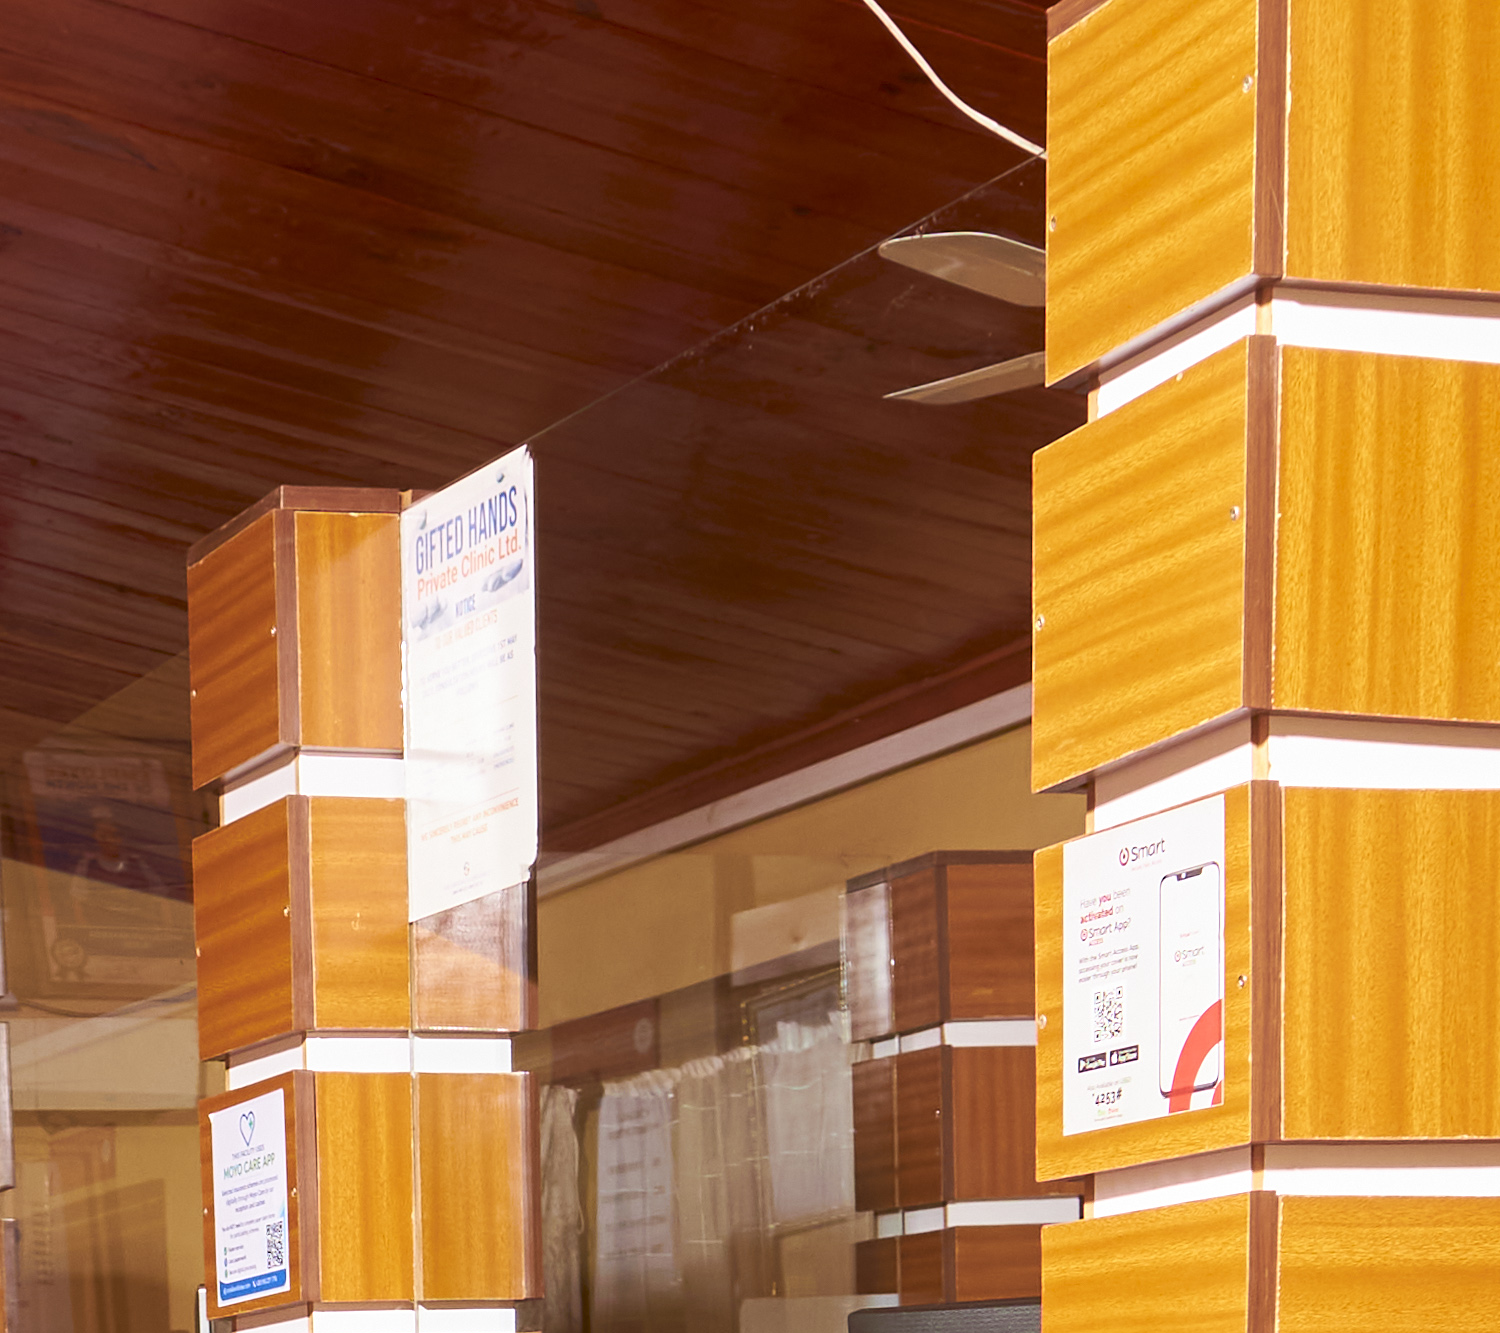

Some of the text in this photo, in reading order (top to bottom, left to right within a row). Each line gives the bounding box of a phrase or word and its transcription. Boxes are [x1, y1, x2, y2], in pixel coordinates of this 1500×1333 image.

[416, 485, 517, 575] GIFTED HANDS
[417, 528, 522, 600] Private Clinic Ltd.
[1131, 838, 1166, 861] Smart
[1099, 894, 1111, 906] you
[1080, 906, 1113, 924] activated
[244, 1157, 261, 1173] CARE
[263, 1152, 275, 1167] APP
